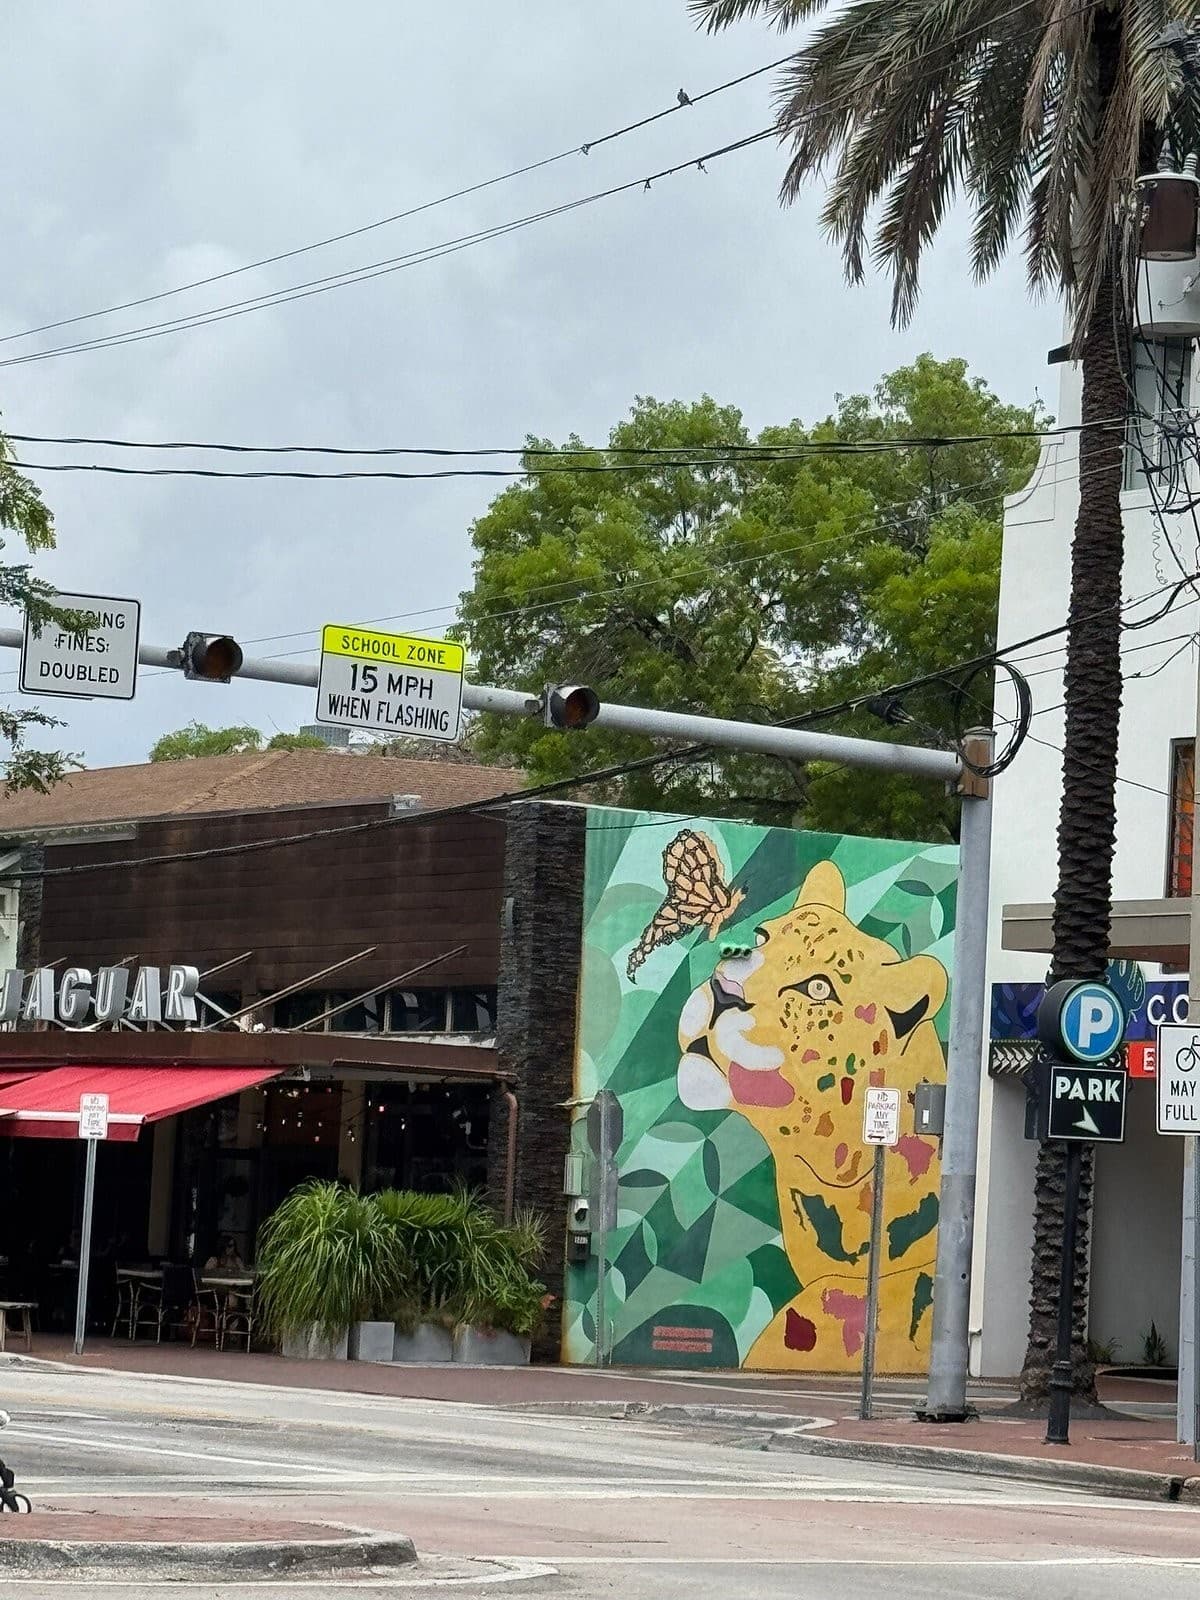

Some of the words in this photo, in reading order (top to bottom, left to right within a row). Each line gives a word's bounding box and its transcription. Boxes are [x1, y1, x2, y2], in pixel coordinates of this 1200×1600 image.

[341, 635, 400, 658] SCHOOL
[407, 645, 446, 664] ZONE
[39, 661, 120, 684] DOUBLED
[350, 663, 378, 694] 15
[387, 673, 434, 700] MPH
[328, 693, 370, 721] WHEN
[376, 701, 449, 732] FLASHING
[0, 964, 200, 1022] JAGUAR
[1077, 995, 1114, 1048] P
[1055, 1076, 1121, 1103] PARK
[1170, 1080, 1197, 1097] MAY
[868, 1102, 896, 1111] PARKING
[1165, 1104, 1198, 1121] FULL
